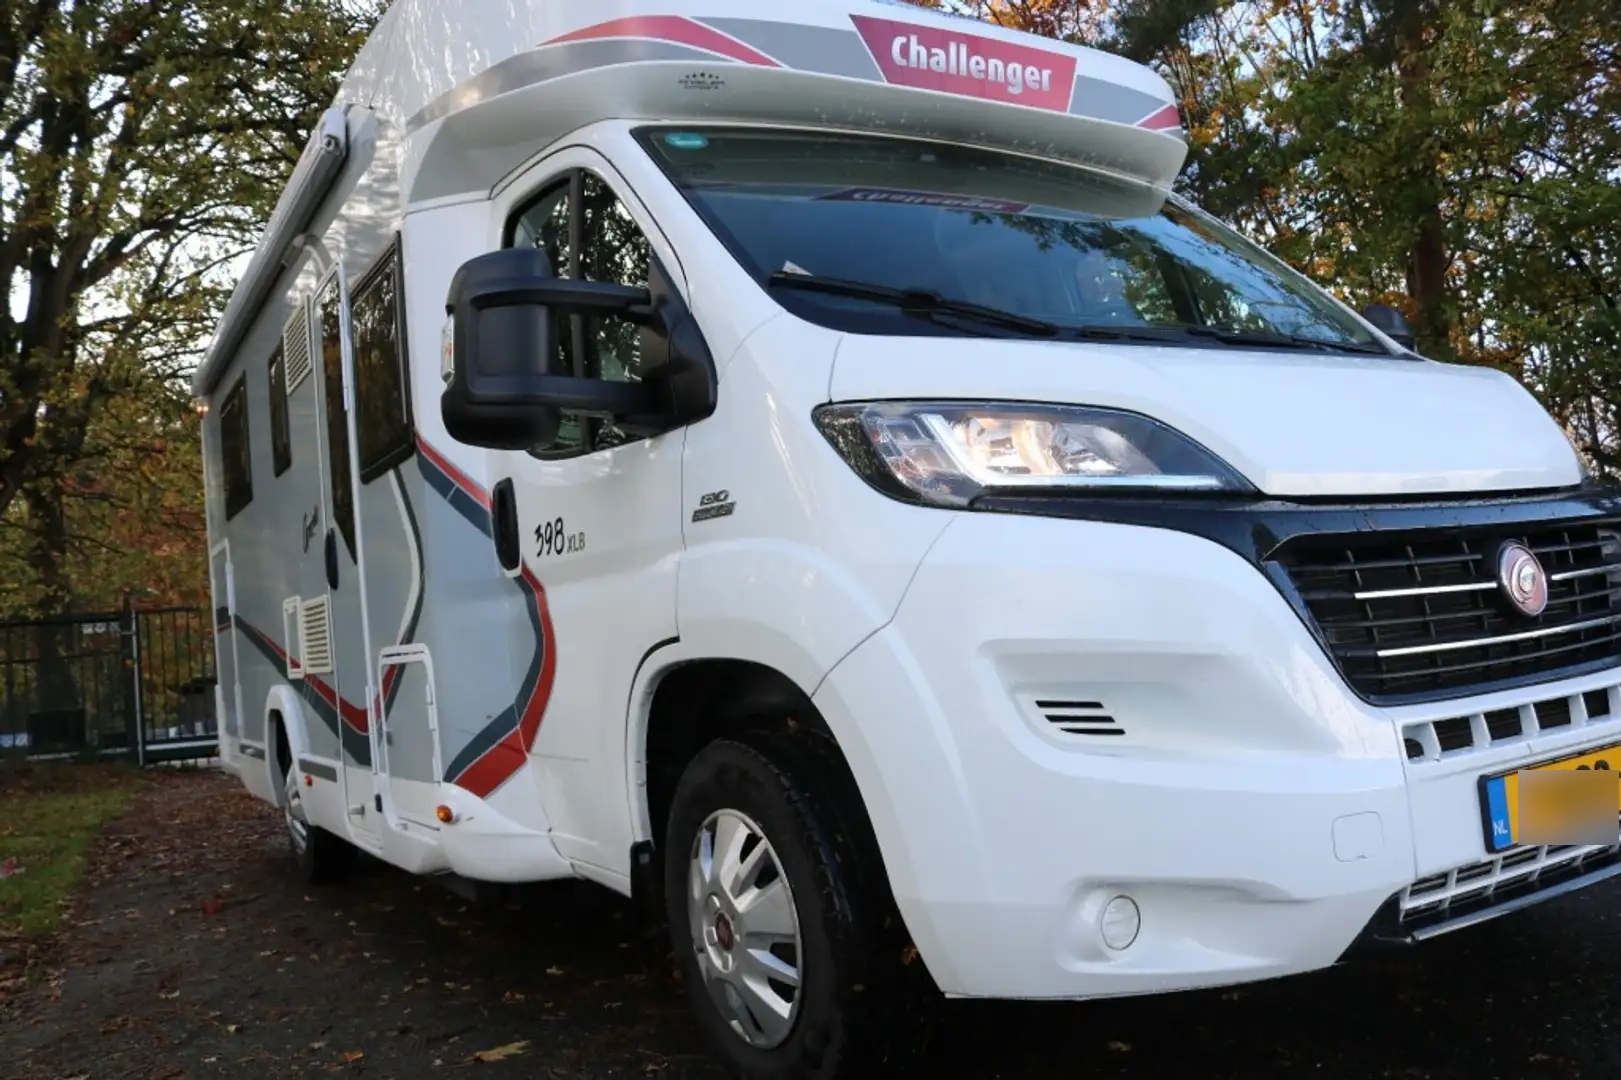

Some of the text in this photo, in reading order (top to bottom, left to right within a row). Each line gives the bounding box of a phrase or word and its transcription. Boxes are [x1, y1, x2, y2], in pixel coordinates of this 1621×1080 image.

[891, 34, 1052, 94] Challenger
[534, 516, 586, 559] 398 XLB
[1493, 819, 1508, 836] NL
